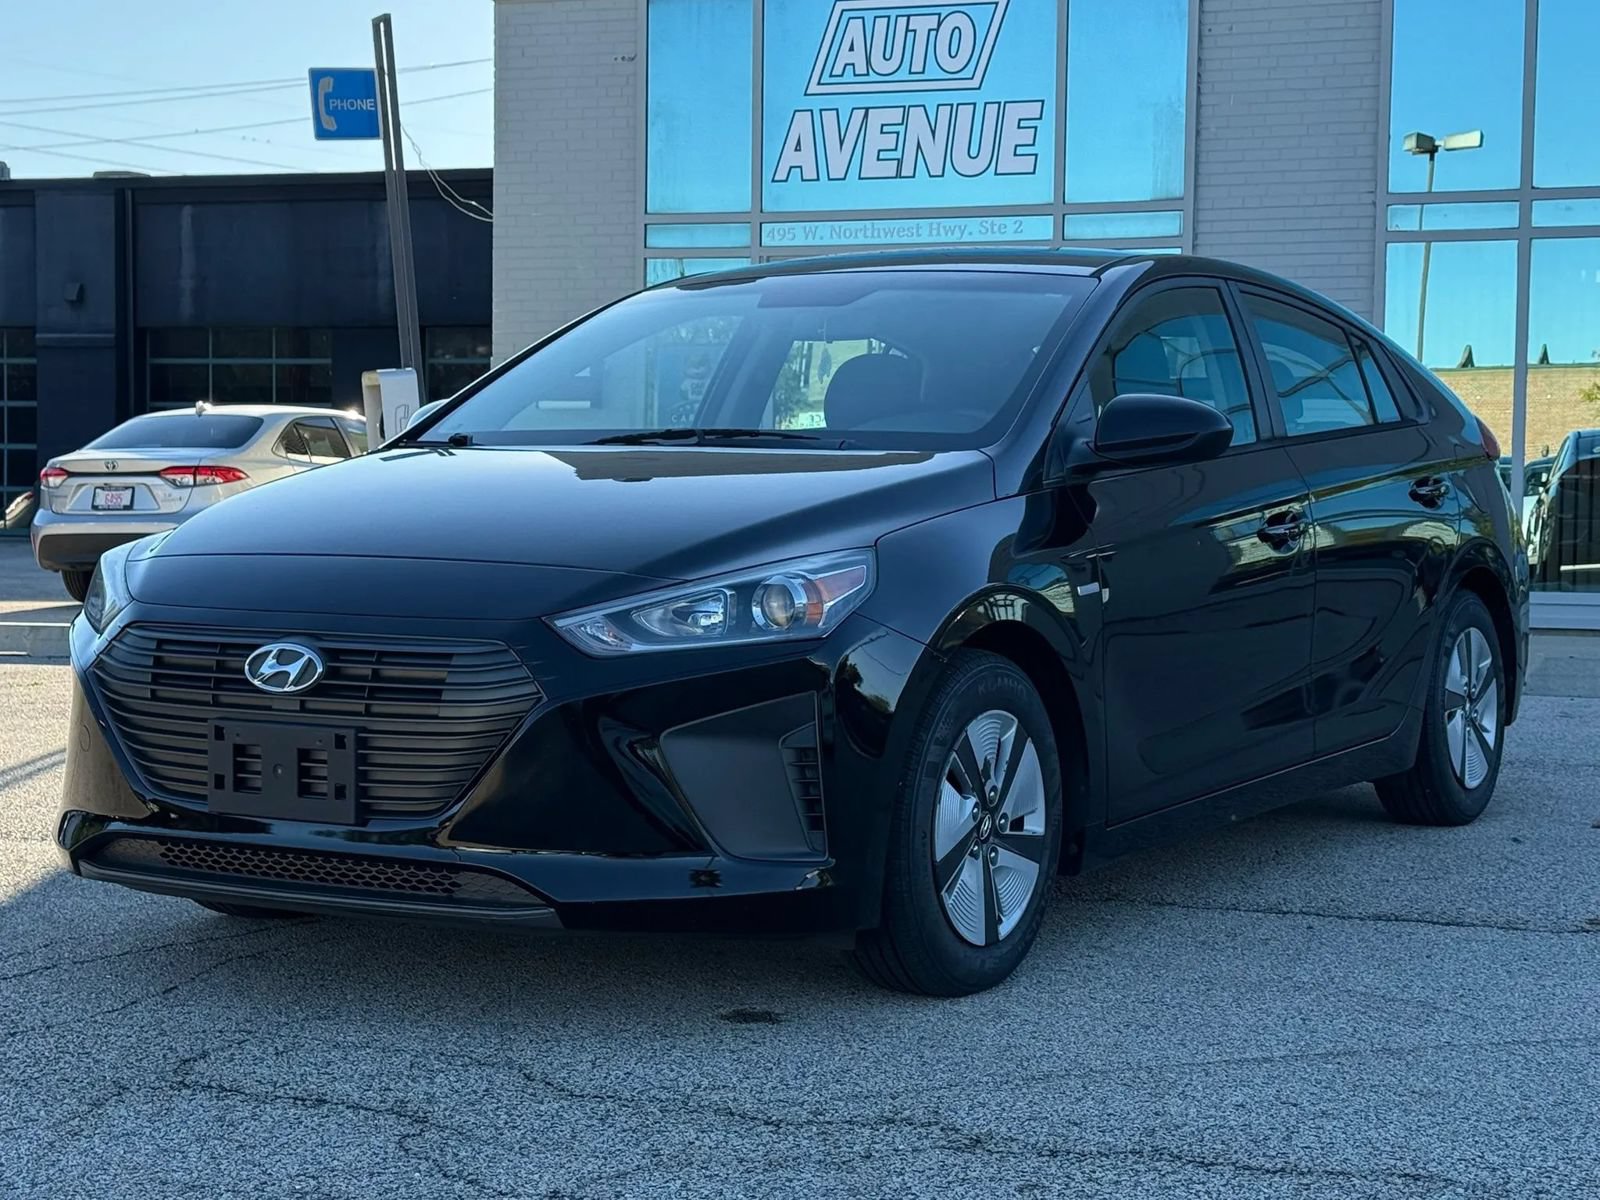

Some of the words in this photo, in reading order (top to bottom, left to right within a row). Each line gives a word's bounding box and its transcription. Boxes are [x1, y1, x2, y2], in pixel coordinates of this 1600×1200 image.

[829, 10, 976, 77] AUTO
[329, 98, 375, 111] PHONE
[771, 99, 1045, 183] AVENUE
[766, 226, 796, 241] 495
[802, 225, 824, 240] W.
[829, 221, 921, 239] Northwest
[927, 221, 973, 240] Hwy.
[979, 219, 1007, 235] Ste
[1013, 219, 1023, 234] 2
